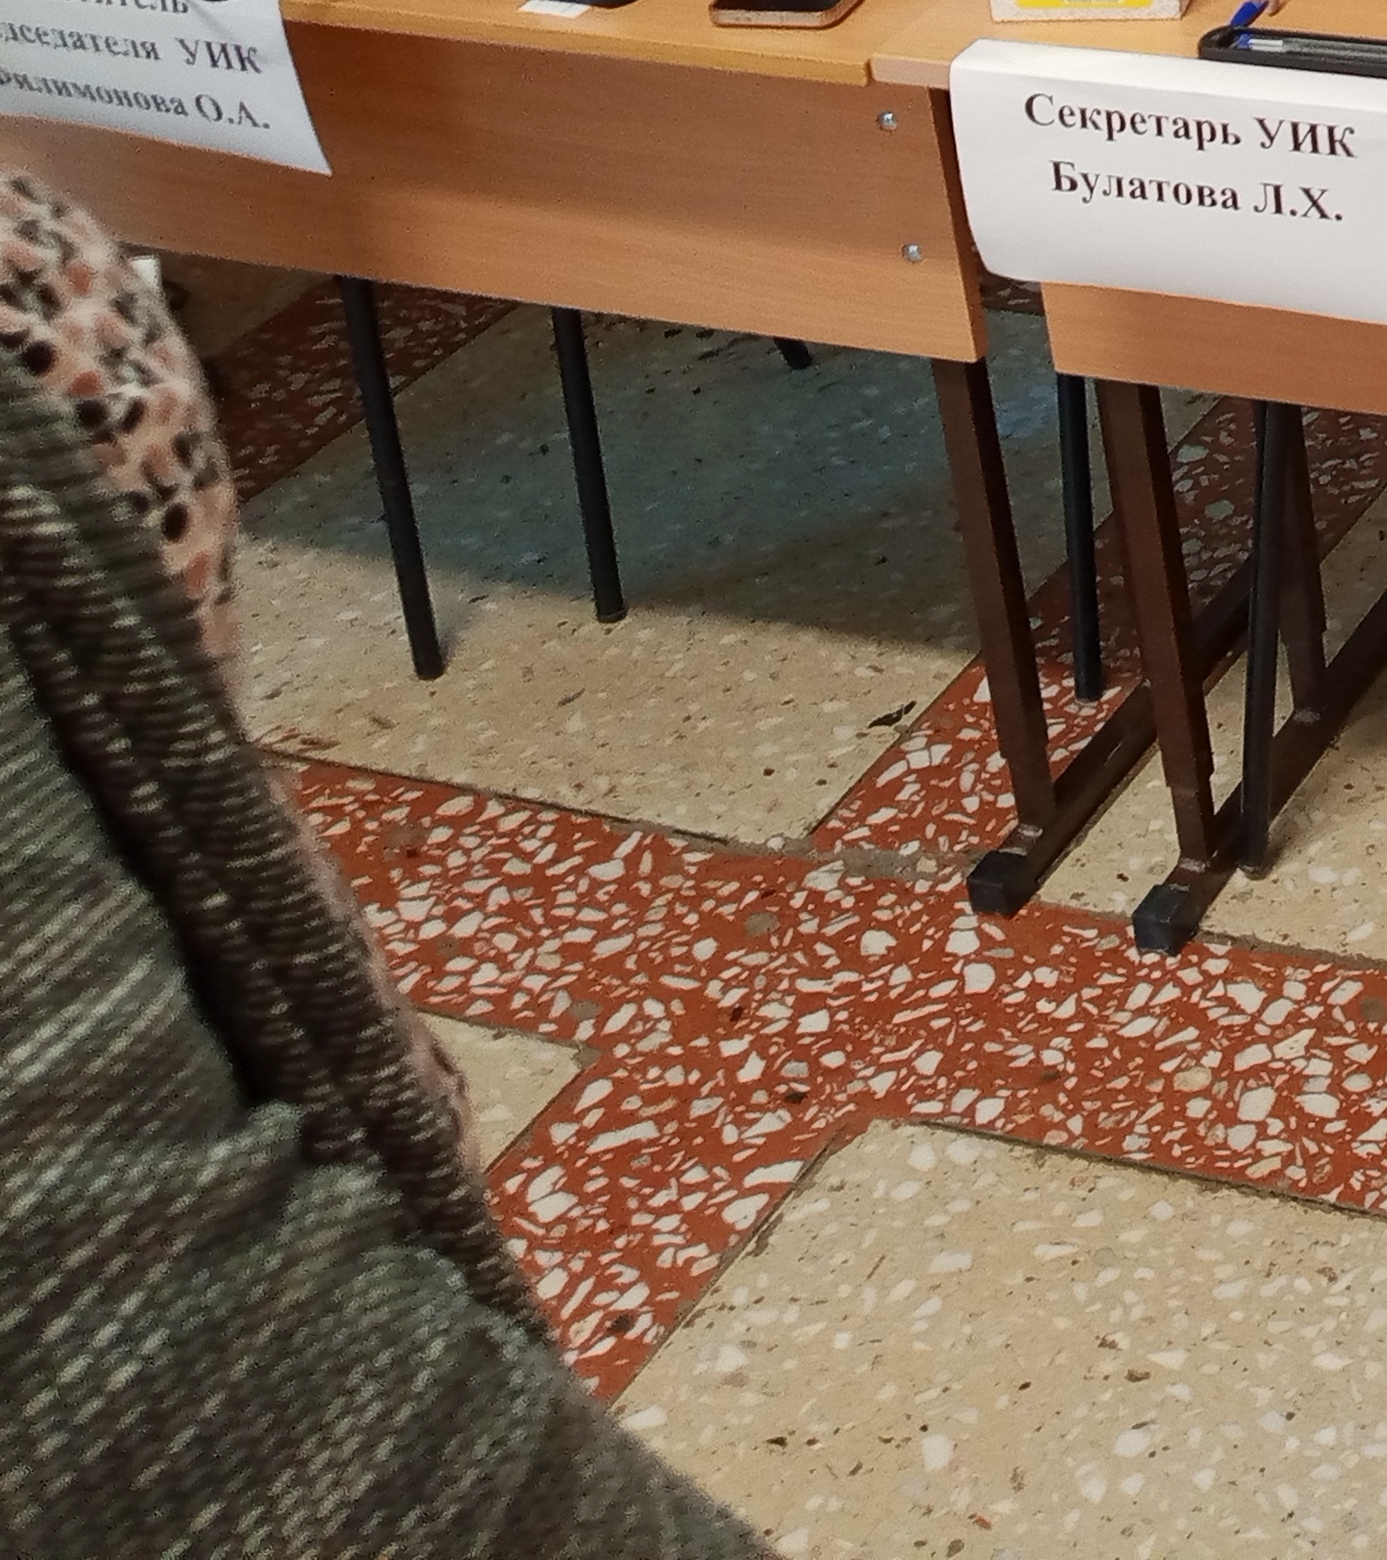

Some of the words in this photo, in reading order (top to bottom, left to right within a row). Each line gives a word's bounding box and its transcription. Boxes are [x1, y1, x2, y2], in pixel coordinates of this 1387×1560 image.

[0, 21, 162, 63] дседателя
[175, 37, 265, 75] УИК
[194, 93, 271, 130] О.А.
[1024, 92, 1242, 151] Секретарь
[1252, 116, 1359, 159] УИК
[1048, 160, 1241, 212] Булатова
[1252, 181, 1345, 222] Л.Х.
